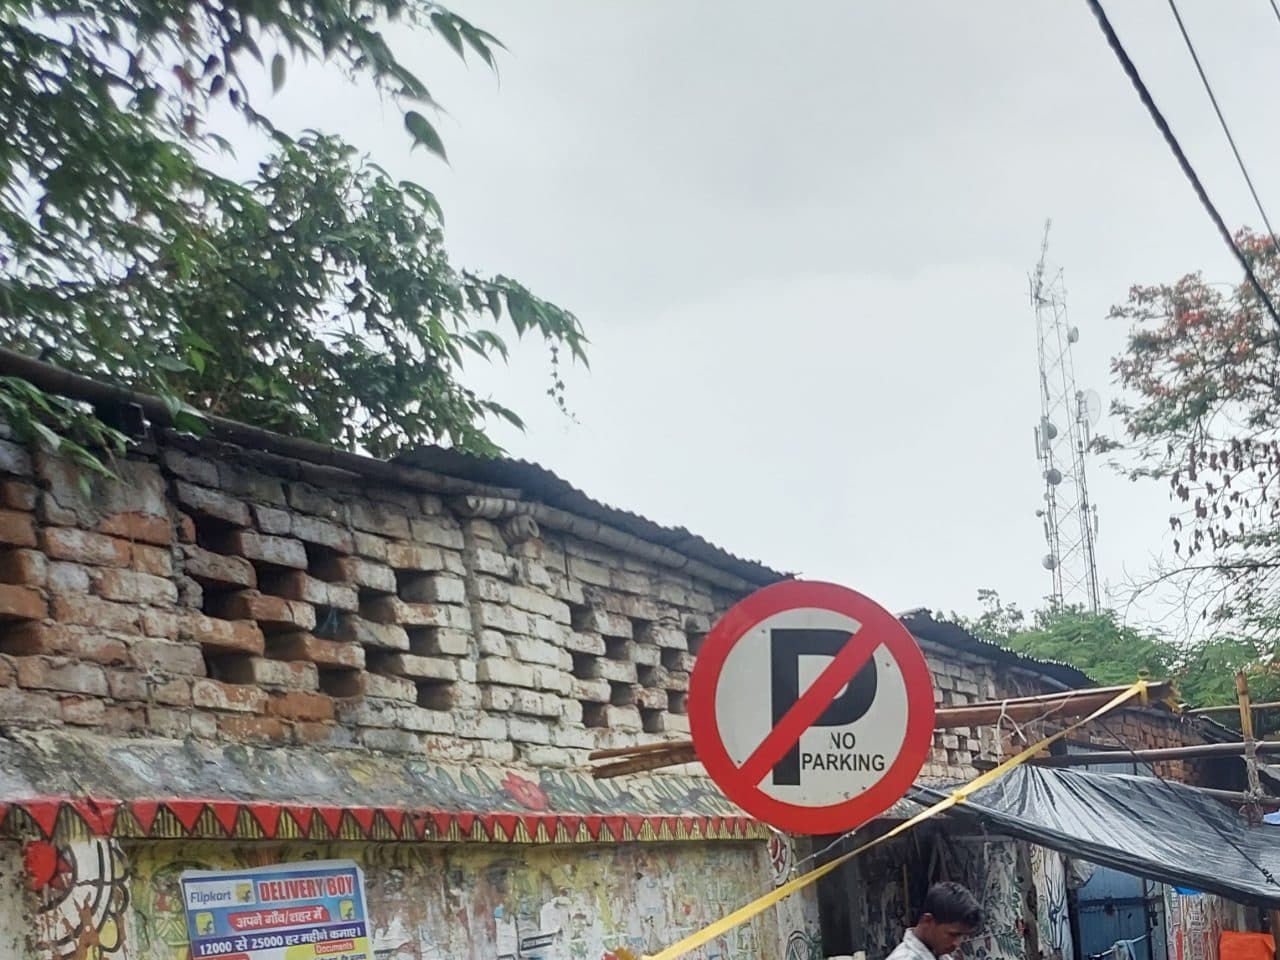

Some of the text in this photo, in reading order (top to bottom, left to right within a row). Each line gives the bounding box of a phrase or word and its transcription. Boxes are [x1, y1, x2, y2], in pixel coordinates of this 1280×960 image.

[830, 731, 856, 750] NO
[802, 753, 885, 772] PARKING
[190, 890, 231, 905] Flipkart
[259, 875, 354, 902] DELIVERY BOY
[200, 940, 232, 955] 12000
[234, 937, 248, 952] से
[251, 935, 283, 949] 25000
[316, 941, 354, 953] Documents
